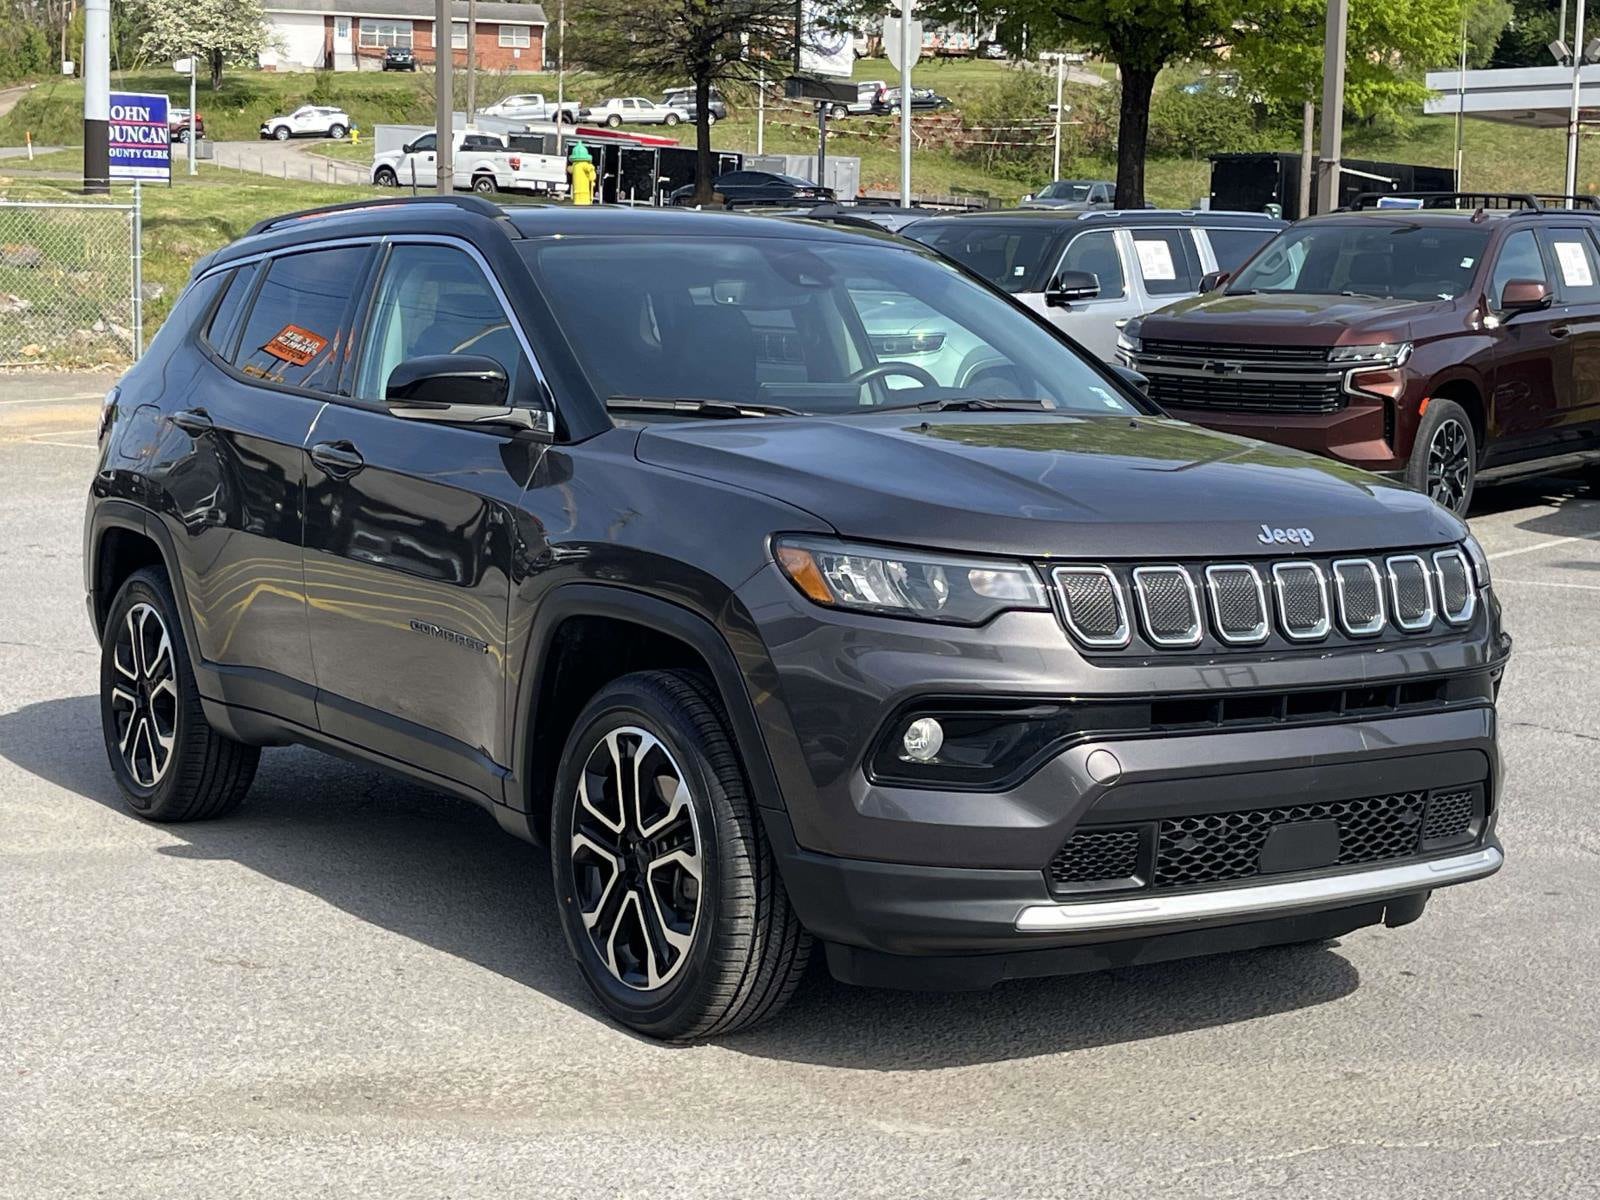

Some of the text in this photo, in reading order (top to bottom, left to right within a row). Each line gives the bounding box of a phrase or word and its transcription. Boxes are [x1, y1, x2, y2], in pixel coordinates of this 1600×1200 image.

[110, 105, 150, 121] OHN
[109, 147, 169, 159] OUNTY CLERK
[1257, 523, 1315, 547] Jeep
[409, 619, 489, 654] COMPASS
